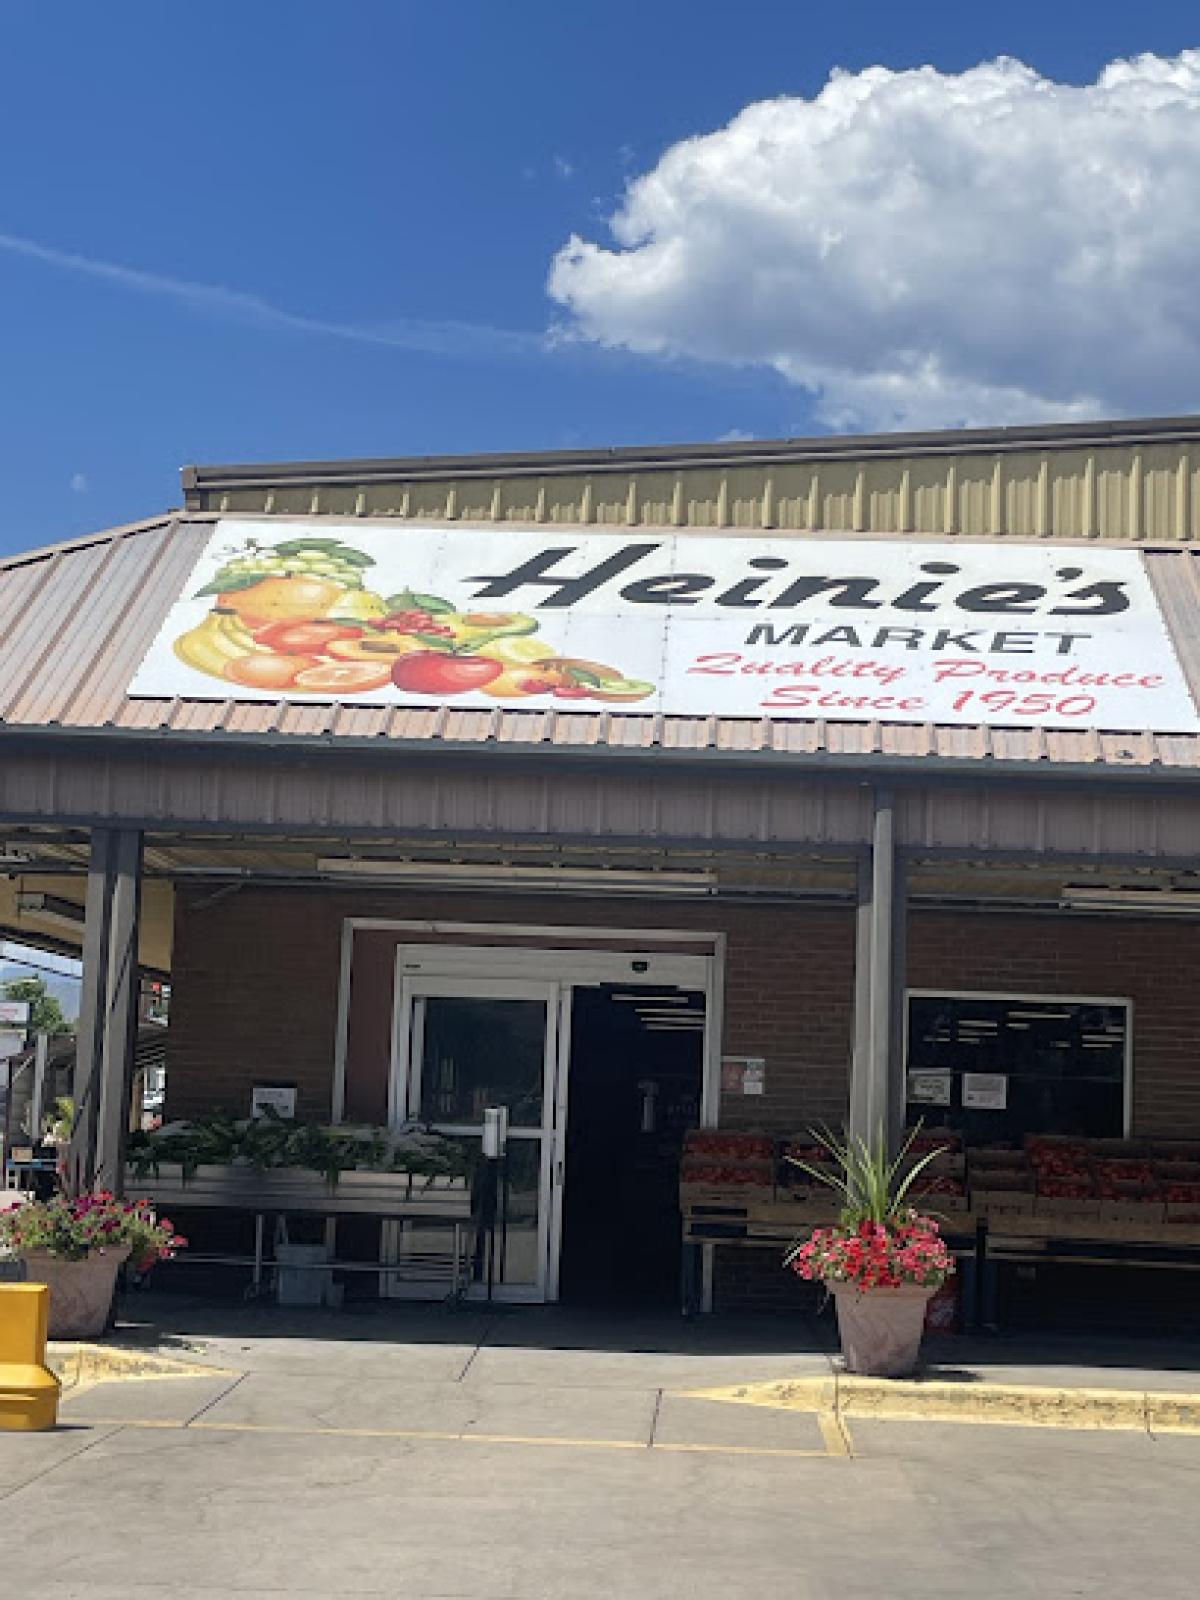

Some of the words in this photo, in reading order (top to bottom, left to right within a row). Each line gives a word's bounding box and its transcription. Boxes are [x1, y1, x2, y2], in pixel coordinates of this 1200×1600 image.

[460, 542, 1131, 615] Heinie's
[744, 623, 1093, 656] MARKET
[686, 652, 906, 686] Quality
[931, 658, 1165, 688] Produce
[759, 684, 926, 711] Since
[952, 690, 1097, 716] 1950
